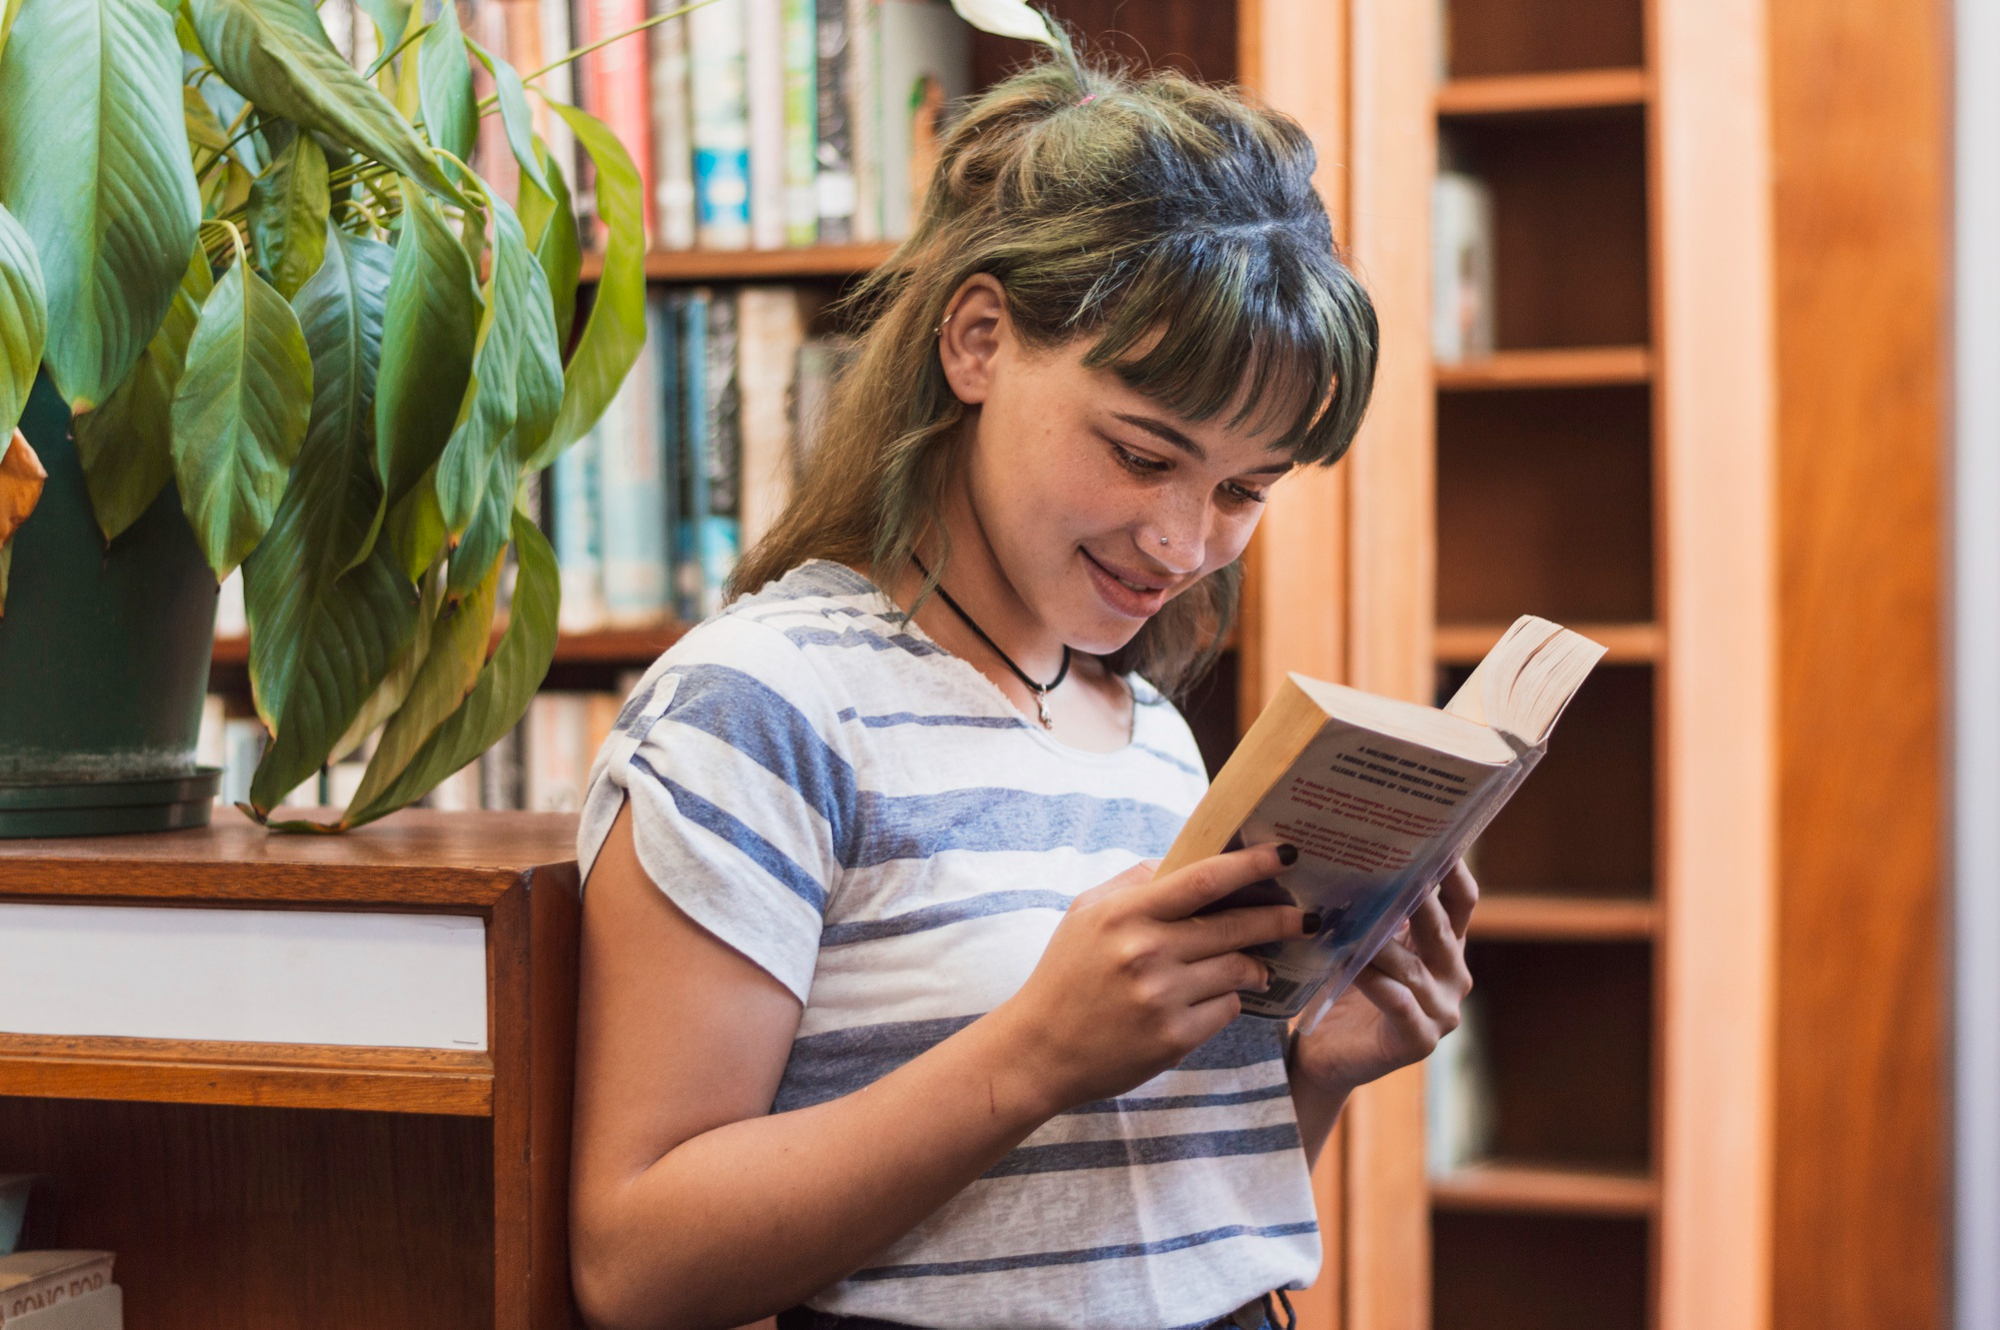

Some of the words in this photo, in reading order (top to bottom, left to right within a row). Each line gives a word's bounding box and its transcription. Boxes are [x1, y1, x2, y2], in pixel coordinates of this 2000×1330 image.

[1343, 754, 1367, 766] ROGUE
[1366, 762, 1399, 776] DICTATOR
[1399, 773, 1434, 787] ROCKETED
[1365, 748, 1398, 762] MILITARY
[1398, 759, 1418, 768] COUP
[1417, 764, 1428, 772] IN
[1427, 768, 1466, 783] INDONESIA
[1330, 764, 1357, 778] ILLEGAL
[1358, 773, 1387, 786] MINING
[1397, 785, 1411, 794] THE
[1410, 789, 1434, 800] OCEAN
[1291, 795, 1324, 810] terrifying
[1331, 807, 1343, 815] the
[1369, 818, 1385, 828] first
[1298, 788, 1333, 802] recruited
[1340, 802, 1368, 813] prevent
[1368, 810, 1403, 824] something
[1326, 787, 1352, 799] threads
[1393, 808, 1413, 818] young
[1303, 821, 1317, 830] this
[1317, 826, 1350, 839] powerful
[1378, 844, 1391, 852] the
[1310, 832, 1333, 842] action
[1332, 839, 1347, 847] and
[1347, 842, 1389, 860] breathtaking
[1303, 848, 1334, 862] shocking
[1313, 842, 1338, 853] create
[1342, 850, 1384, 867] geophysical
